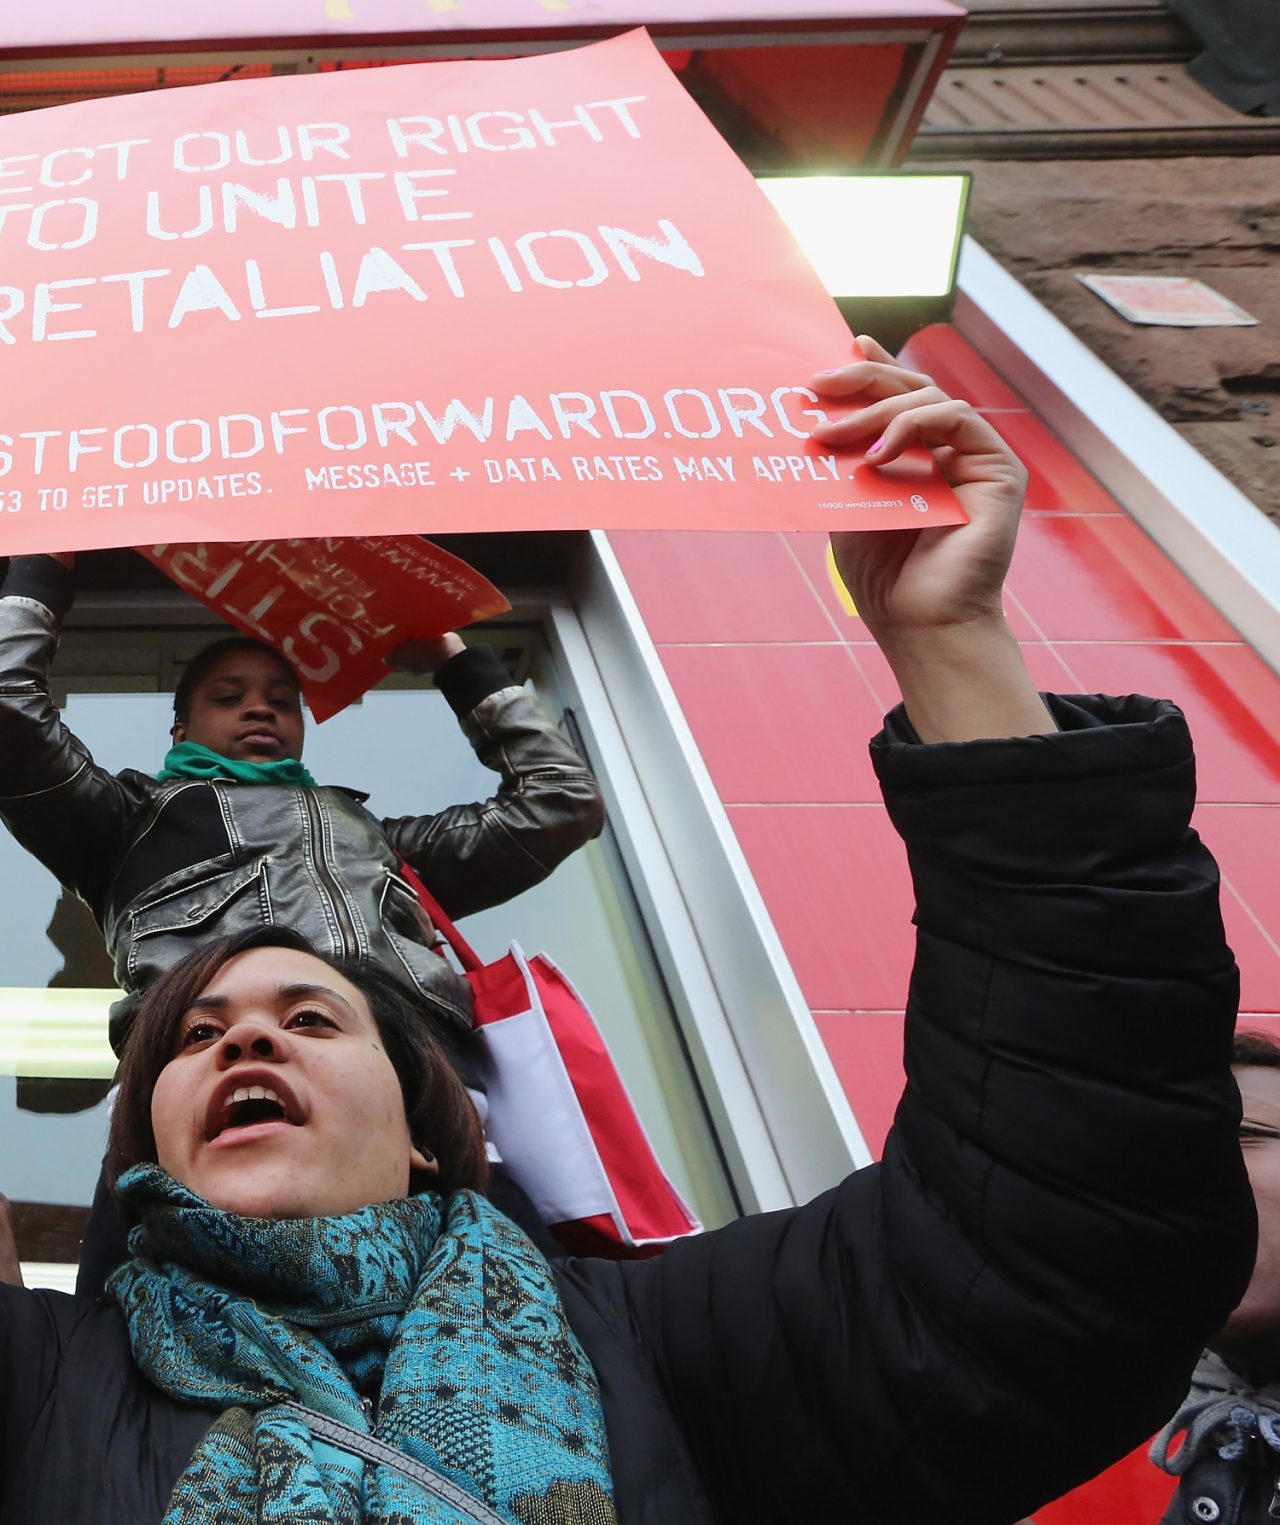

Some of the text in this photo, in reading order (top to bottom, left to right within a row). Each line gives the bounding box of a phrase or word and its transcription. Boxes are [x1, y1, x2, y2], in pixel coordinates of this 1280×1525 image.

[173, 122, 351, 173] OUR
[387, 95, 647, 158] RIGHT
[147, 168, 474, 241] UNITE
[38, 487, 68, 512] TO
[82, 484, 128, 508] GET
[144, 471, 272, 504] UPDATES.
[304, 461, 436, 492] MESSAGE
[485, 457, 561, 485] DATA
[574, 455, 663, 482] RATES
[675, 454, 737, 482] MAY
[754, 454, 855, 482] APPLY.
